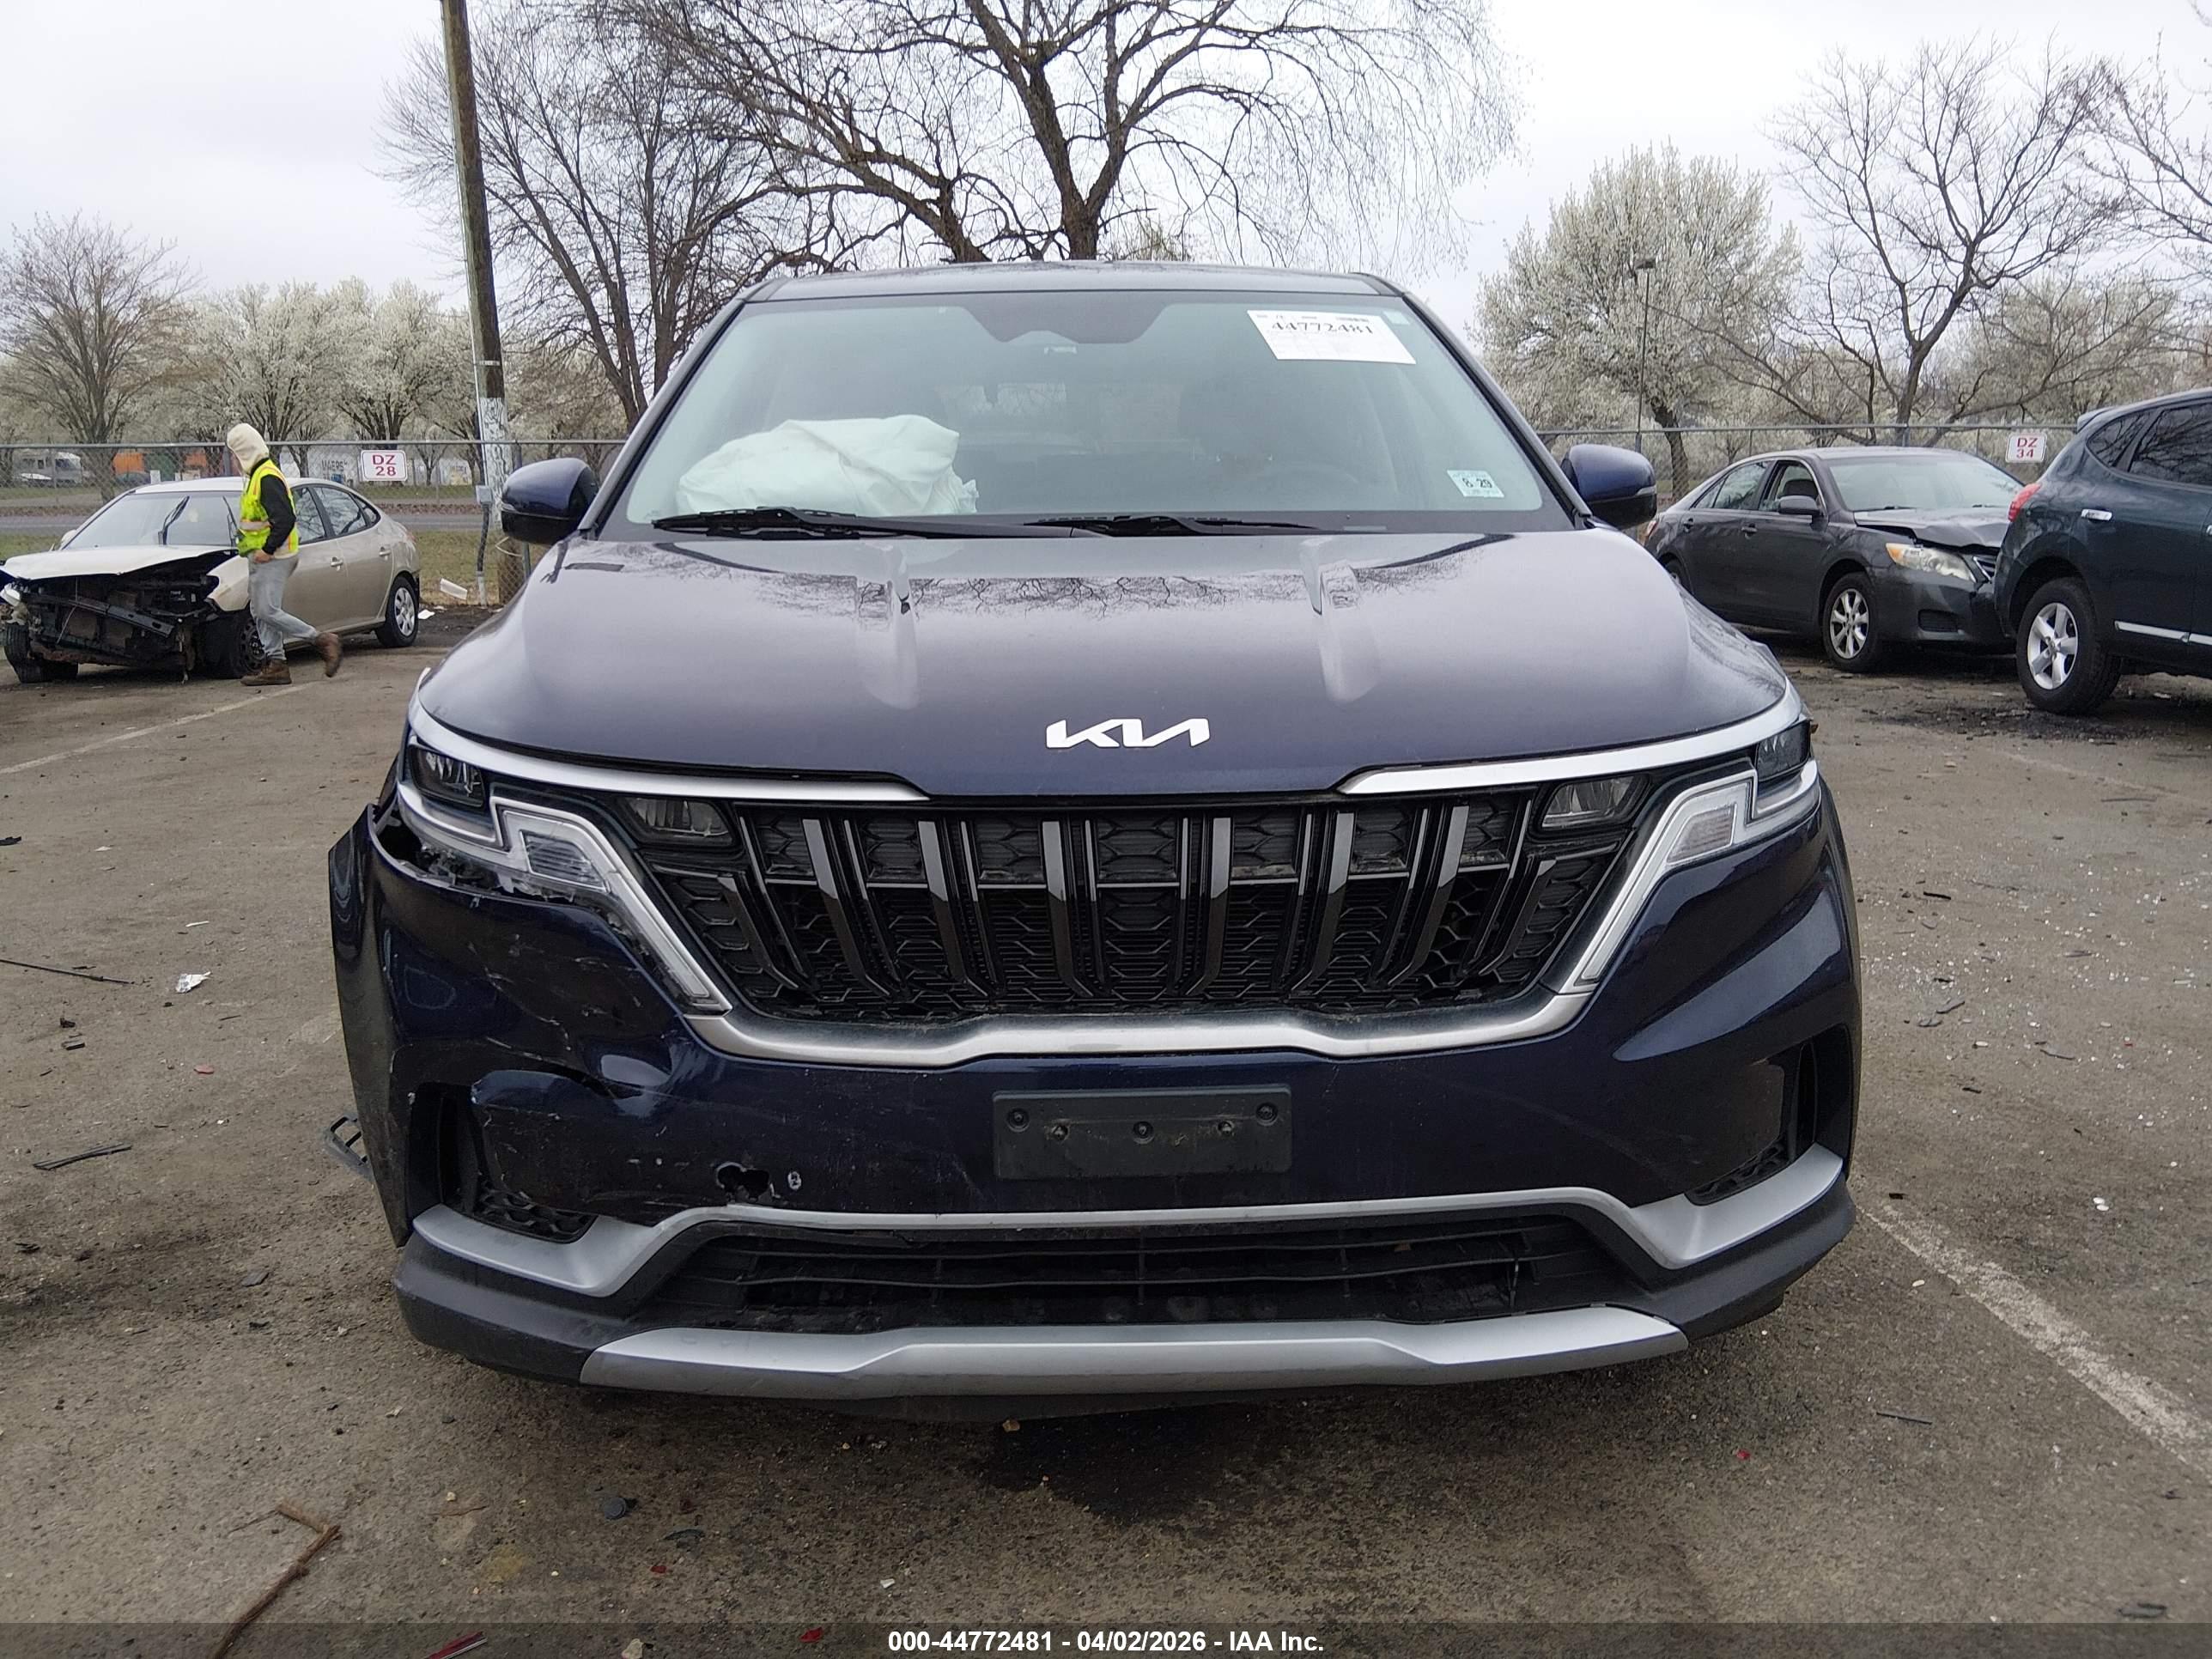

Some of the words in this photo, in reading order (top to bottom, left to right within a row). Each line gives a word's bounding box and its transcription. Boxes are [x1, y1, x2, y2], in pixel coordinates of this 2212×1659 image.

[2017, 437, 2038, 447] DZ
[2016, 448, 2034, 458] 34
[372, 453, 397, 465] DZ
[375, 465, 397, 477] 28
